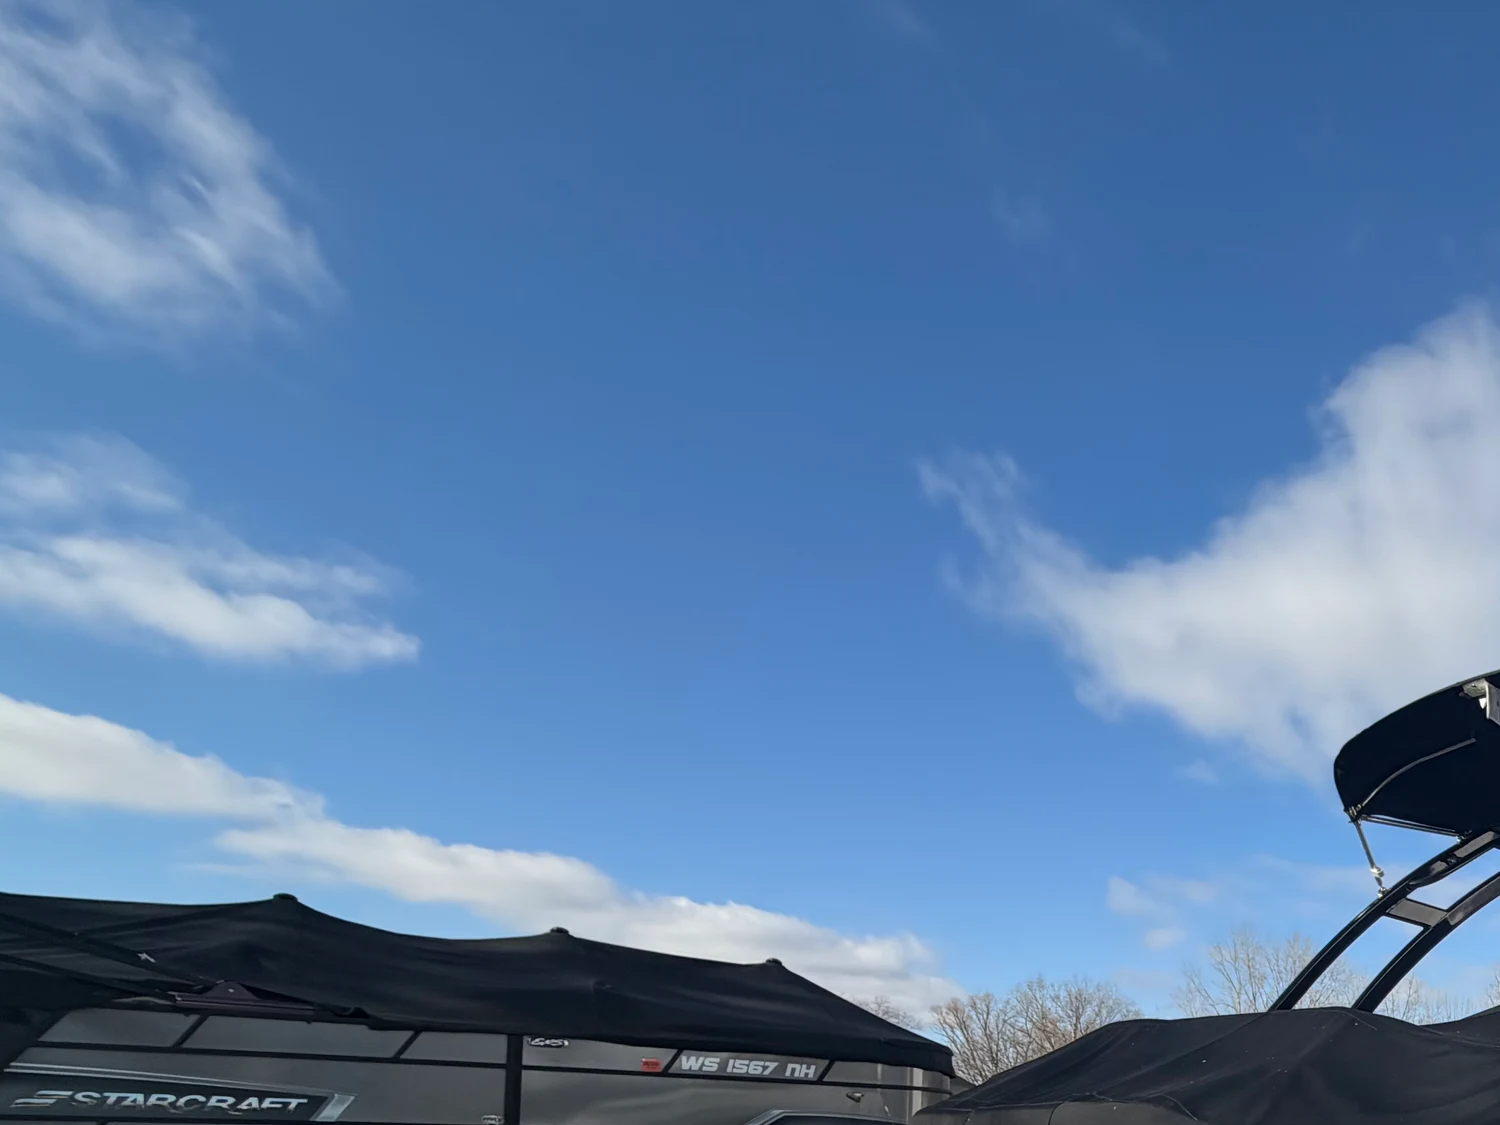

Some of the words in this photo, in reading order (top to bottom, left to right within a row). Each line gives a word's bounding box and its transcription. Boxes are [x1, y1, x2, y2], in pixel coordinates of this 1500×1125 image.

[680, 1055, 719, 1072] WS
[726, 1059, 779, 1075] 1567
[784, 1064, 816, 1078] NH
[72, 1090, 308, 1115] STARCRAFT
